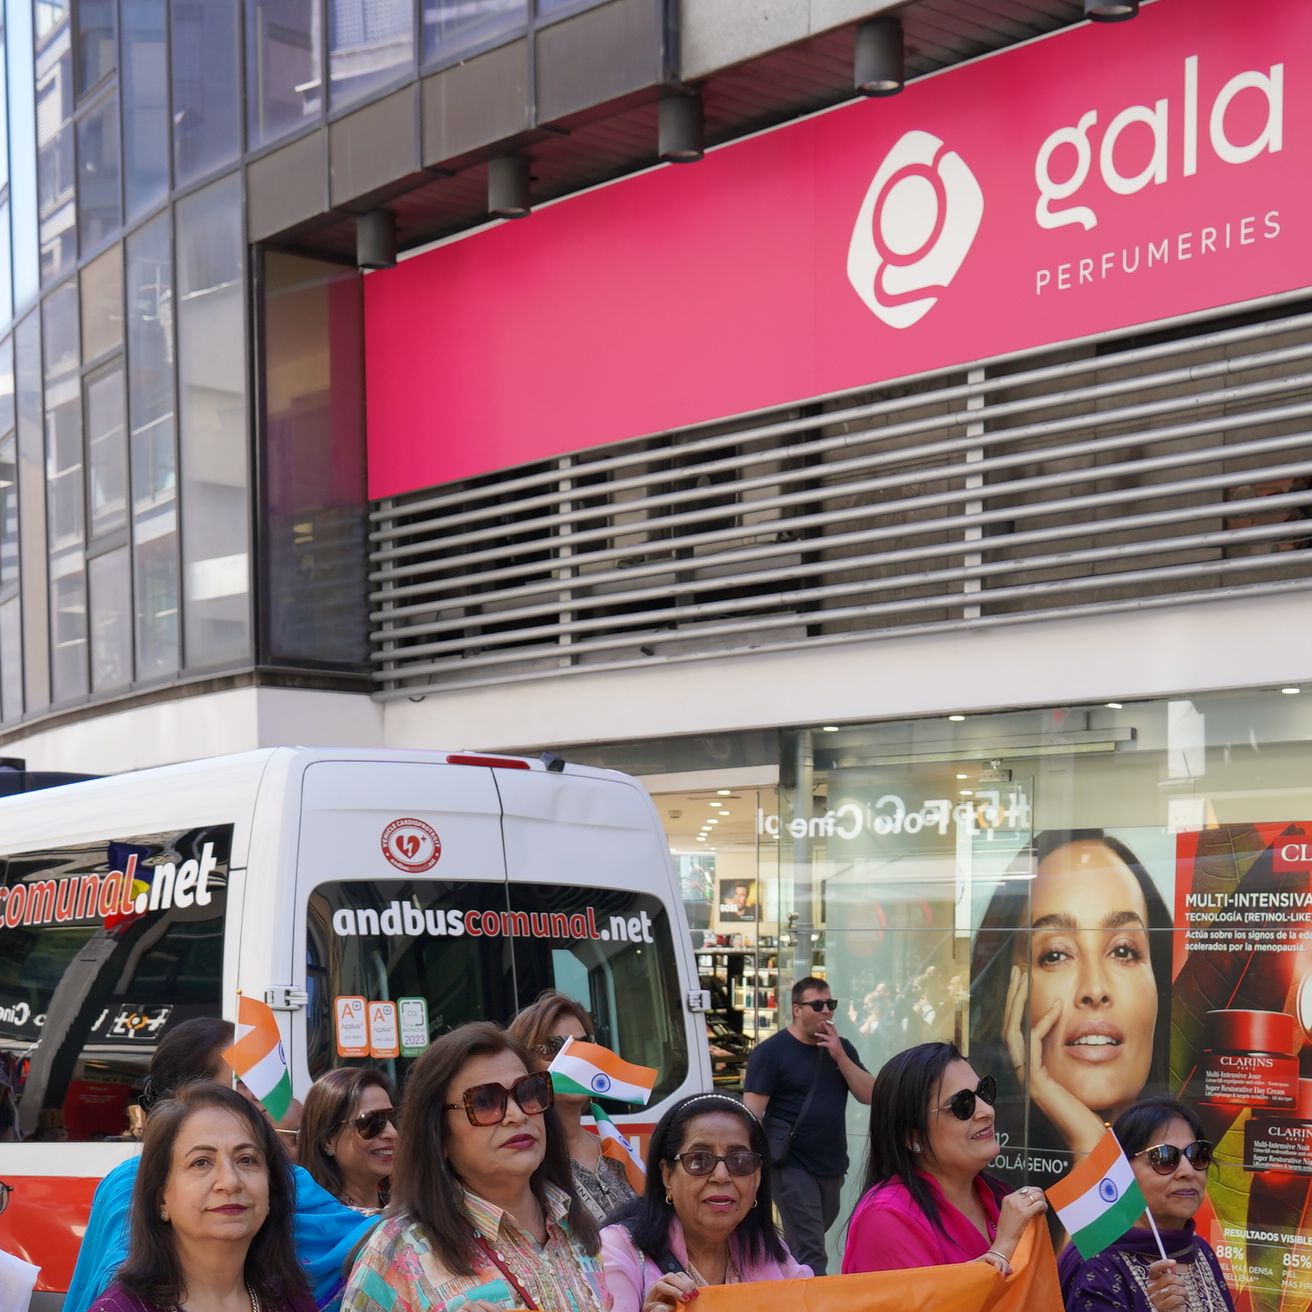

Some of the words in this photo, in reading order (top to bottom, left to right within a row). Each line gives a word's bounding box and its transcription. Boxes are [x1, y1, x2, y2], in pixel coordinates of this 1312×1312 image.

[1035, 55, 1284, 231] gala
[1035, 210, 1282, 296] PERFUMERIES
[332, 900, 654, 943] andbuscomunal.net
[1185, 912, 1242, 922] TECNOLOGÍA
[1185, 929, 1208, 939] Actúa
[1209, 930, 1233, 939] sobre
[1234, 930, 1246, 939] los
[1248, 930, 1274, 942] signos
[1275, 930, 1287, 940] de
[1288, 930, 1297, 940] la
[1184, 941, 1227, 951] acelerados
[1228, 943, 1243, 953] por
[1244, 942, 1252, 951] la
[404, 1034, 426, 1045] 2023
[1220, 1056, 1274, 1067] CLARINS
[1224, 1228, 1279, 1242] RESULTADOS
[1216, 1245, 1244, 1260] 88%
[1282, 1253, 1312, 1269] 85%
[1249, 1266, 1274, 1276] DENSA
[1282, 1269, 1297, 1279] PIEL
